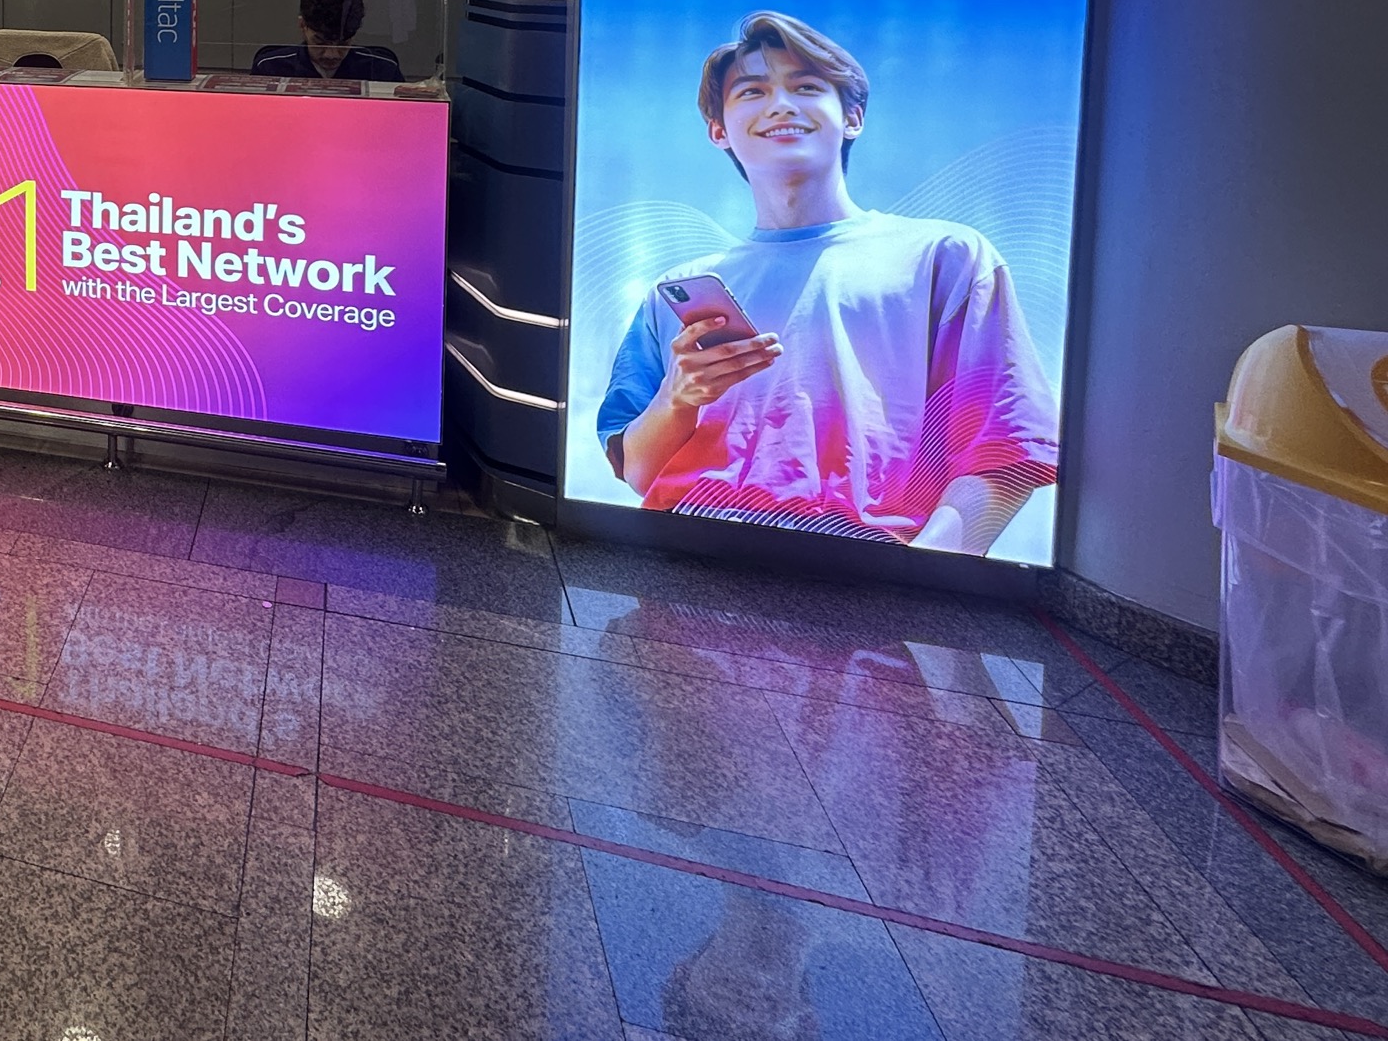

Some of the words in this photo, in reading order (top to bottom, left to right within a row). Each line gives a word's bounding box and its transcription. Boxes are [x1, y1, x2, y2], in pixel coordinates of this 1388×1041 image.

[61, 189, 306, 245] Thailand's
[62, 230, 167, 276] Best
[177, 240, 396, 296] Network
[62, 276, 111, 300] with
[114, 280, 155, 304] the
[162, 284, 258, 315] Largest
[263, 293, 396, 331] Coverage
